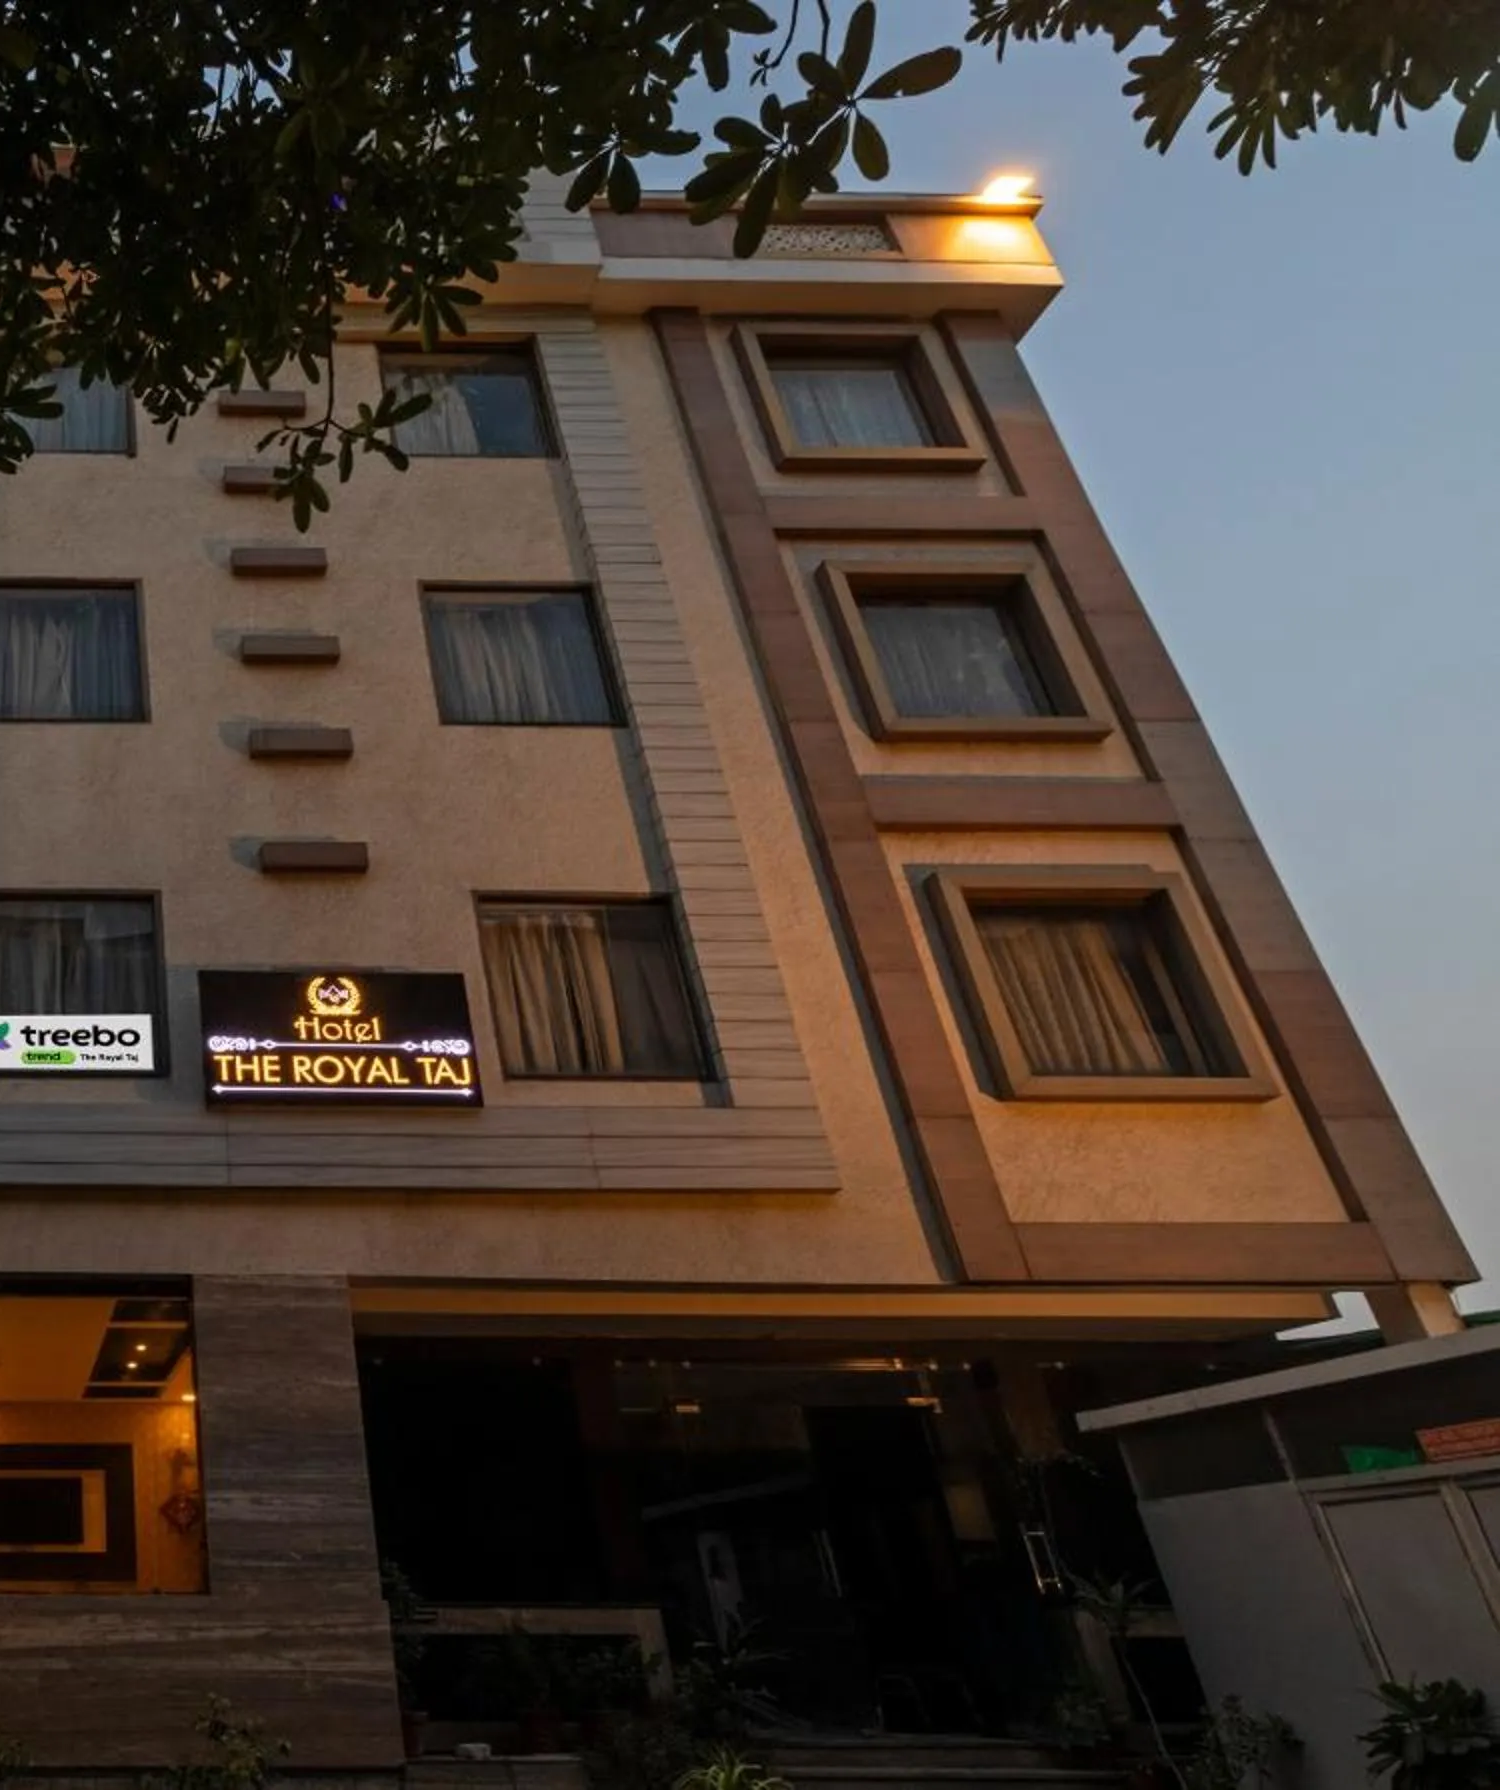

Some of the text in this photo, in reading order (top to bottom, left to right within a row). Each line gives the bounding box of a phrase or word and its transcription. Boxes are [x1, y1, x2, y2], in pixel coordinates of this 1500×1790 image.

[20, 1025, 141, 1047] treebo
[294, 1016, 381, 1042] Hotel
[26, 1051, 61, 1061] trend
[80, 1053, 139, 1063] The Royal Taj
[213, 1055, 472, 1086] THE ROYAL TAJ
